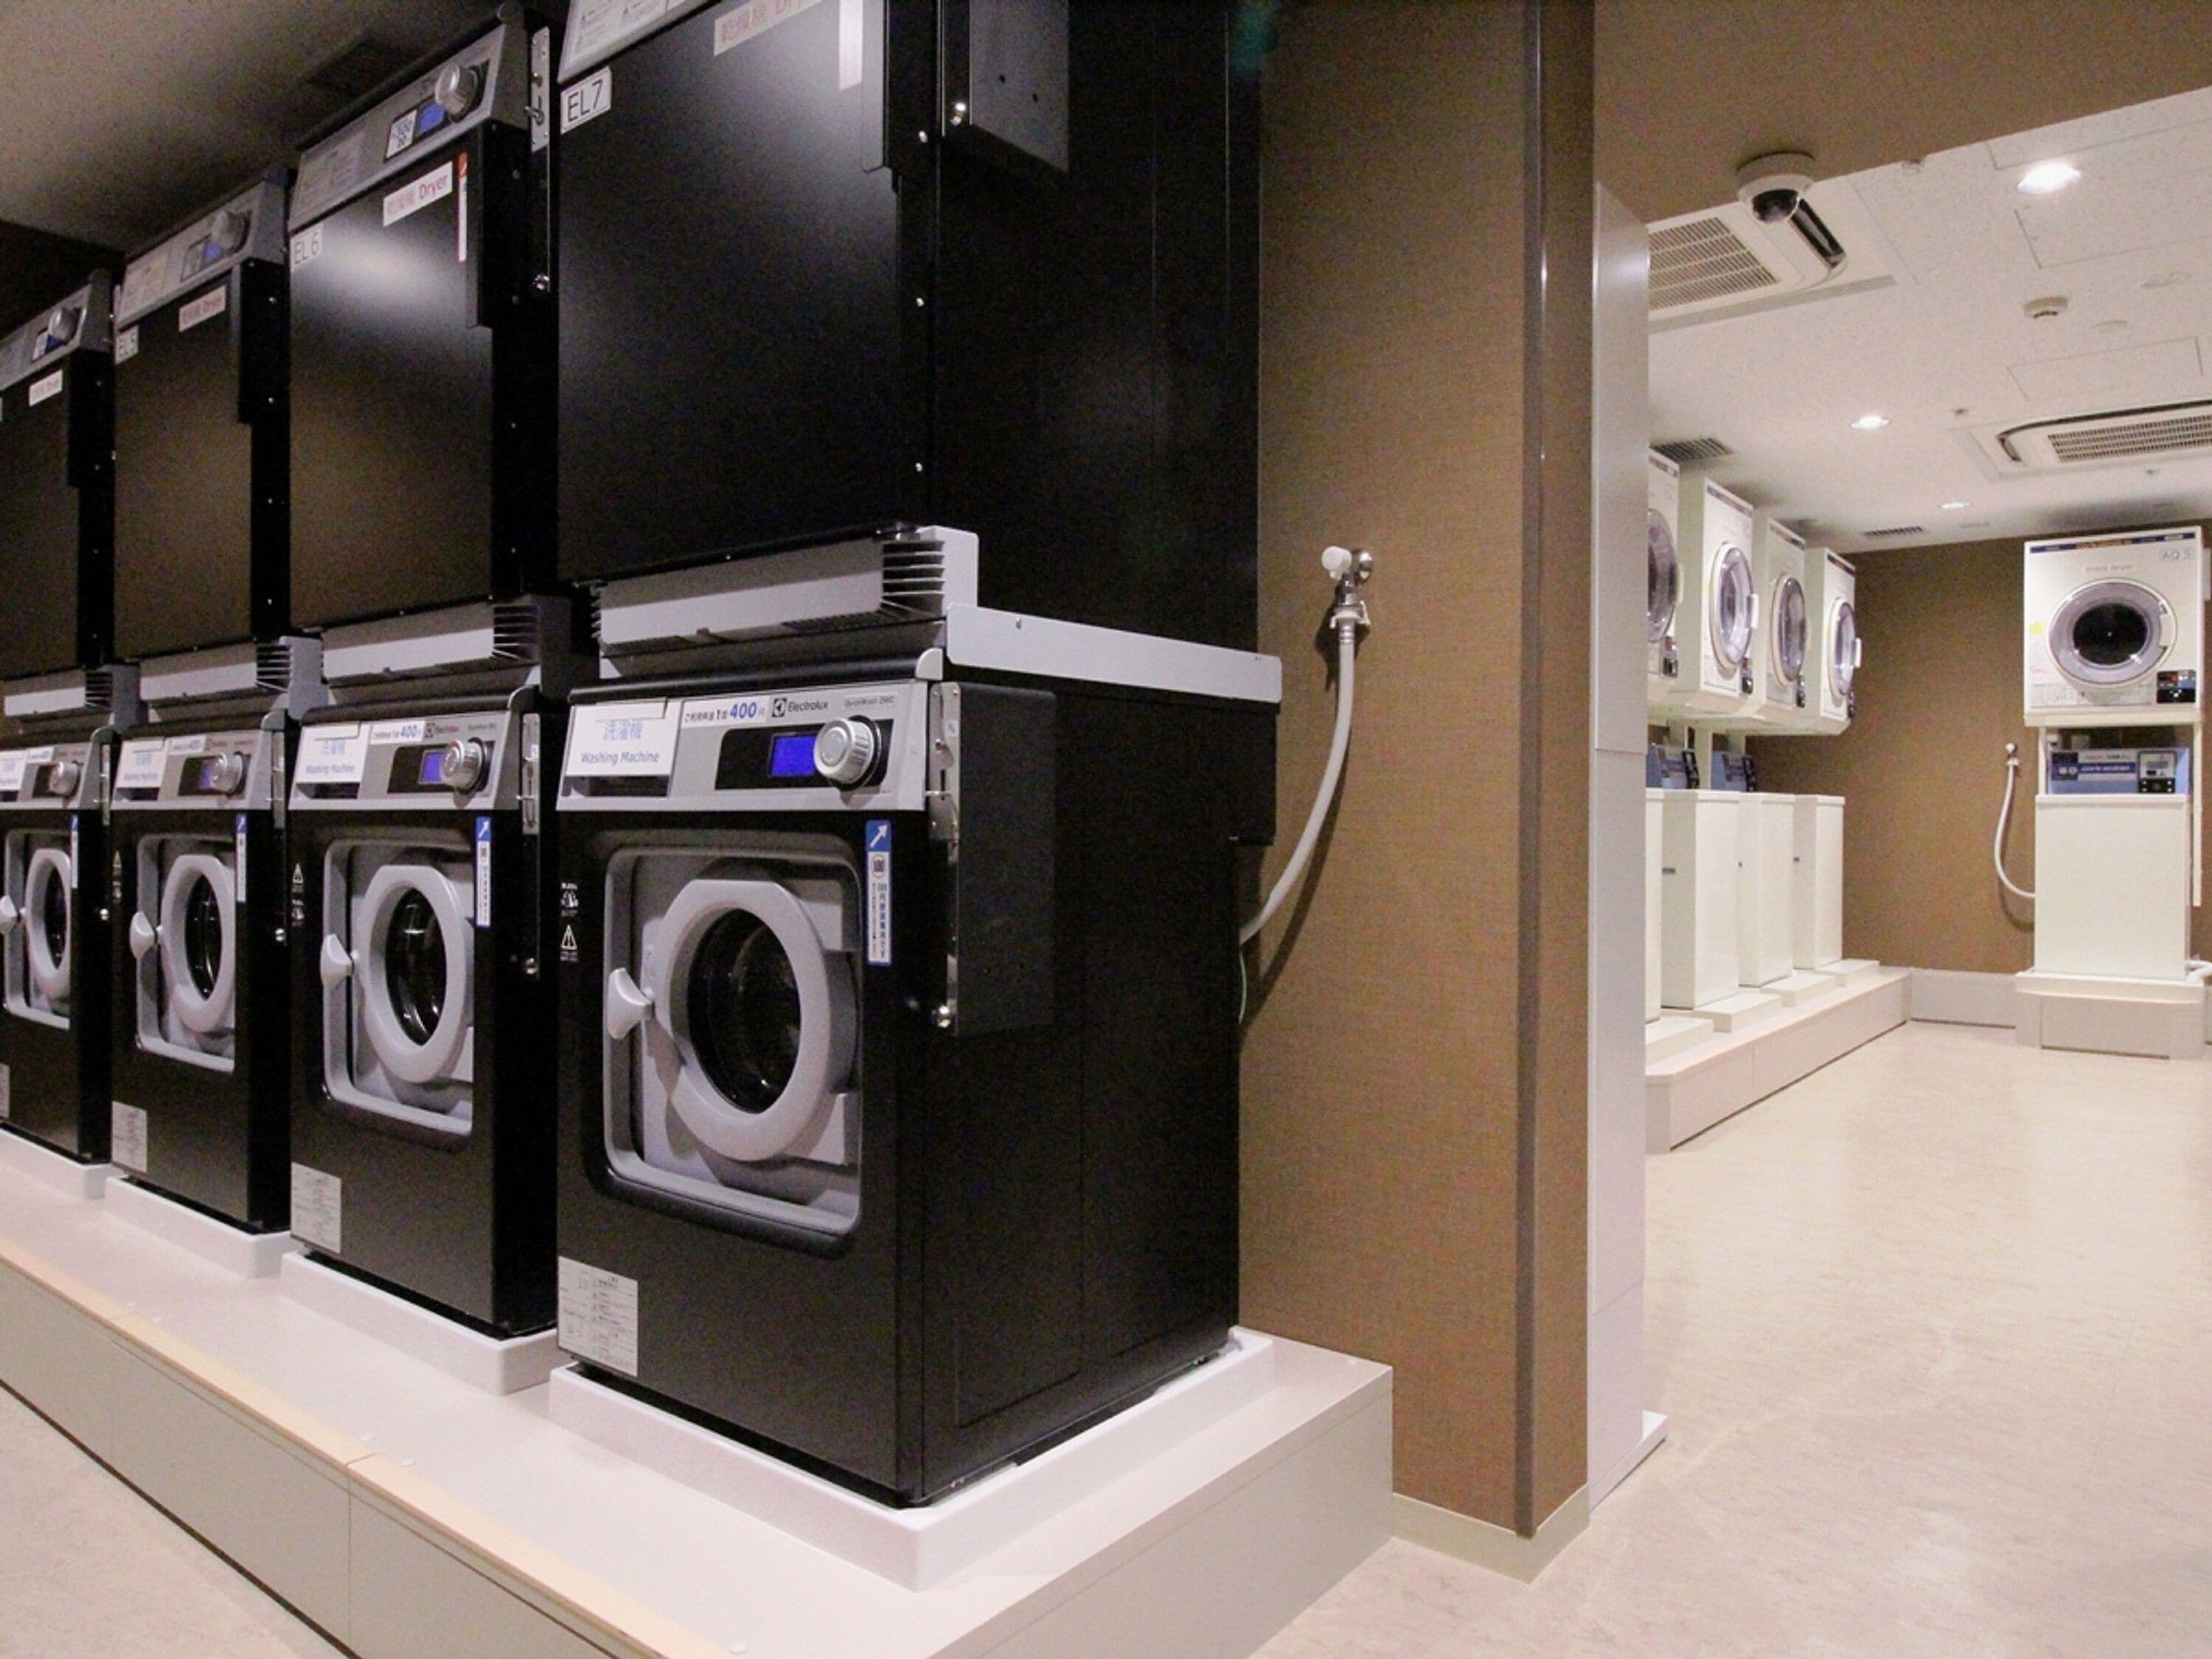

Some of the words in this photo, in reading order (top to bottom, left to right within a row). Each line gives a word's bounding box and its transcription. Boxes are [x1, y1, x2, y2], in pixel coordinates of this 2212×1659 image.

[567, 79, 604, 123] EL7
[419, 174, 448, 200] Dryer
[787, 700, 828, 713] Electrolux
[581, 753, 619, 765] Washing
[620, 751, 660, 763] Machine
